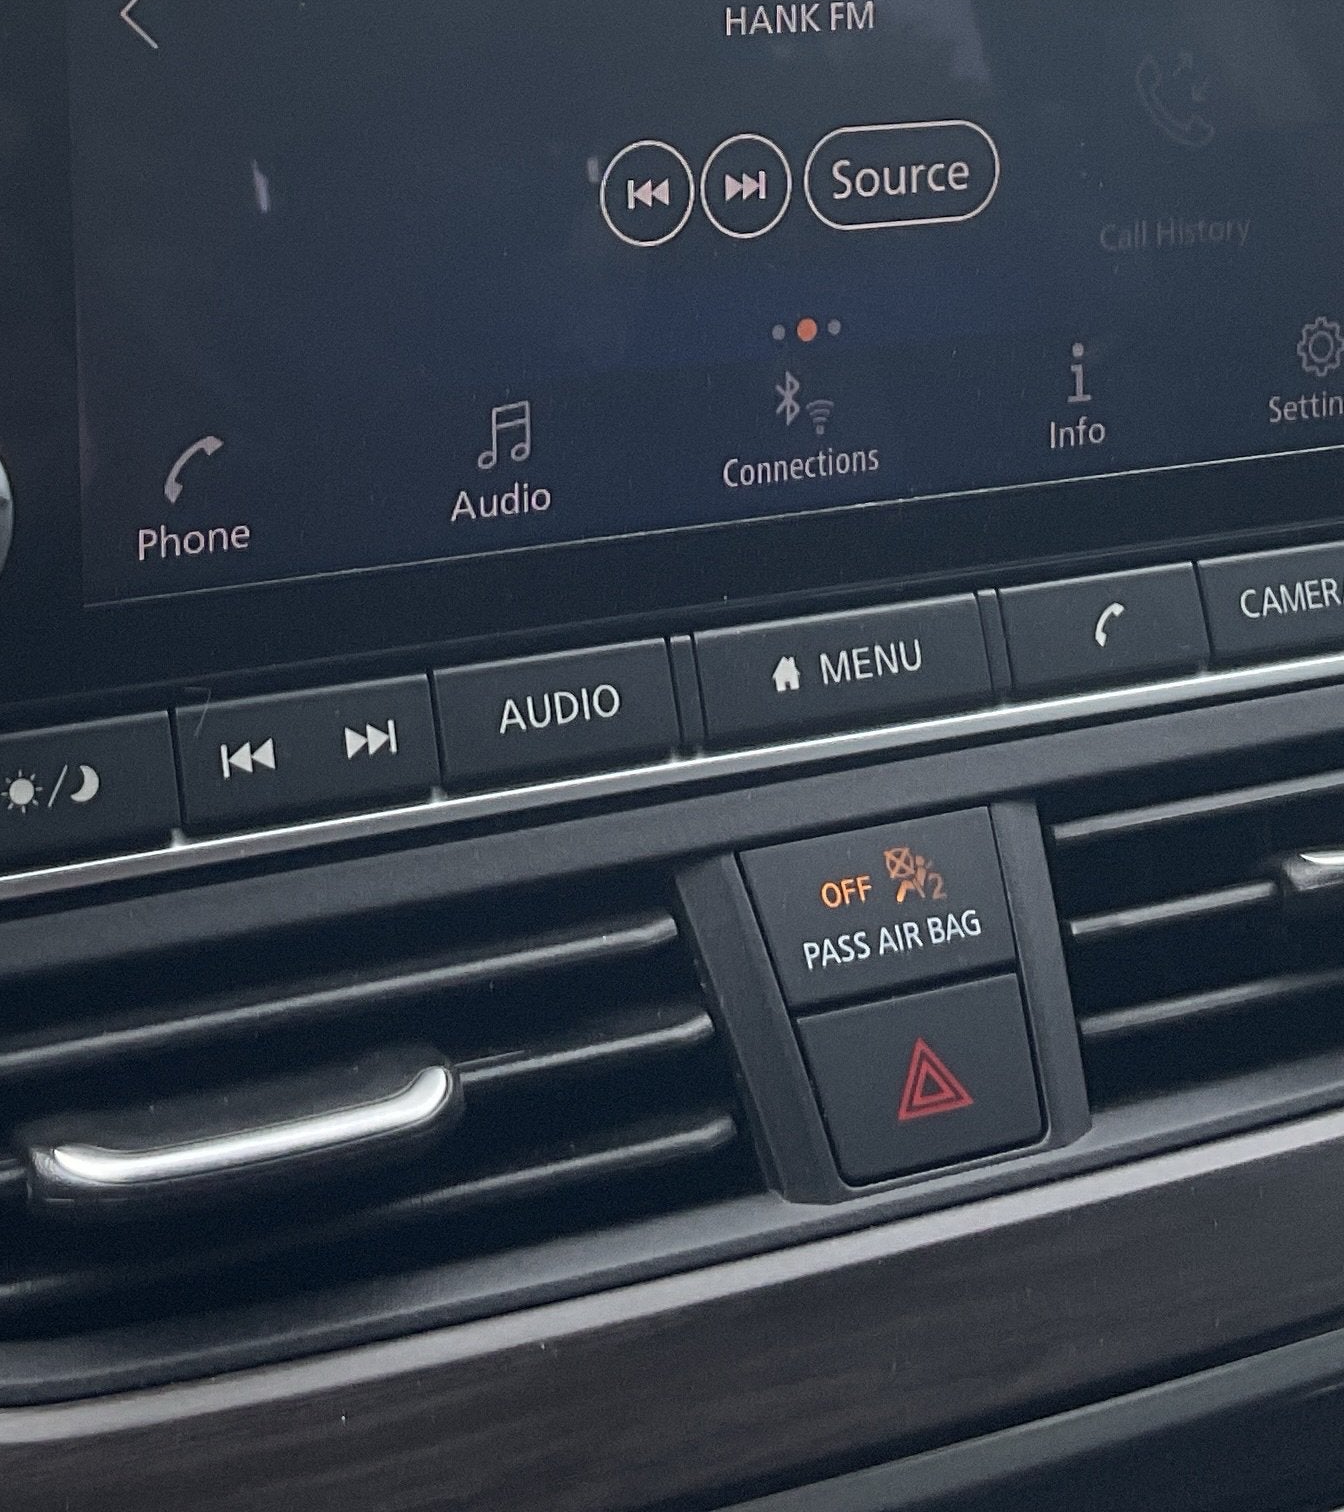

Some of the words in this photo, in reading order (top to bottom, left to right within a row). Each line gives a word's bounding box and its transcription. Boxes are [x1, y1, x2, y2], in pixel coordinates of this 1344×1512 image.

[725, 2, 822, 38] HANK
[829, 0, 875, 32] FM
[831, 158, 971, 201] Source
[1098, 219, 1148, 253] Call
[1156, 215, 1252, 254] History
[1049, 418, 1107, 451] Info
[721, 442, 880, 488] Connections
[449, 481, 552, 523] Audio
[137, 518, 251, 563] Phone
[819, 638, 923, 686] MENU
[498, 683, 621, 735] AUDIO
[820, 874, 873, 909] OFF
[802, 930, 872, 971] PASS
[878, 920, 925, 956] AIR
[926, 908, 983, 945] BAG
